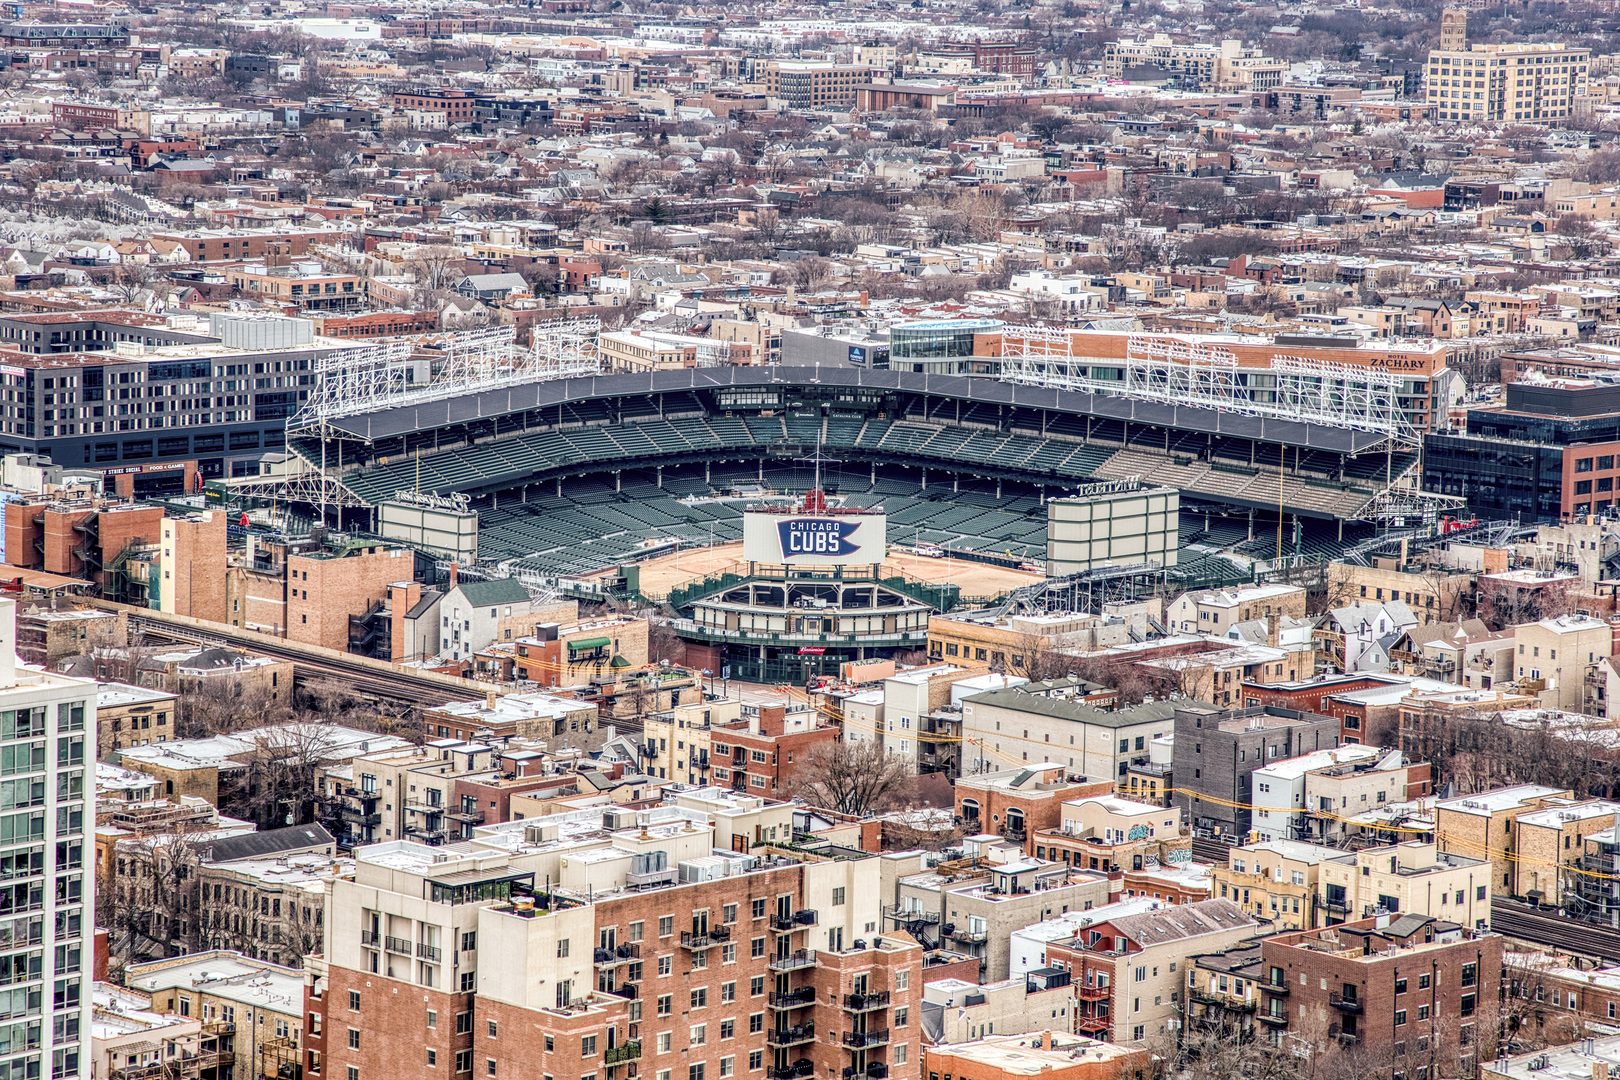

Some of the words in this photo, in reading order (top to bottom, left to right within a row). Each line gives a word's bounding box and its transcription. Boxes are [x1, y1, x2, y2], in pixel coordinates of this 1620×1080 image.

[1370, 358, 1425, 368] ZACHARY
[108, 467, 124, 475] STRIKE
[790, 522, 840, 531] CHICAGO
[790, 531, 840, 552] CUBS
